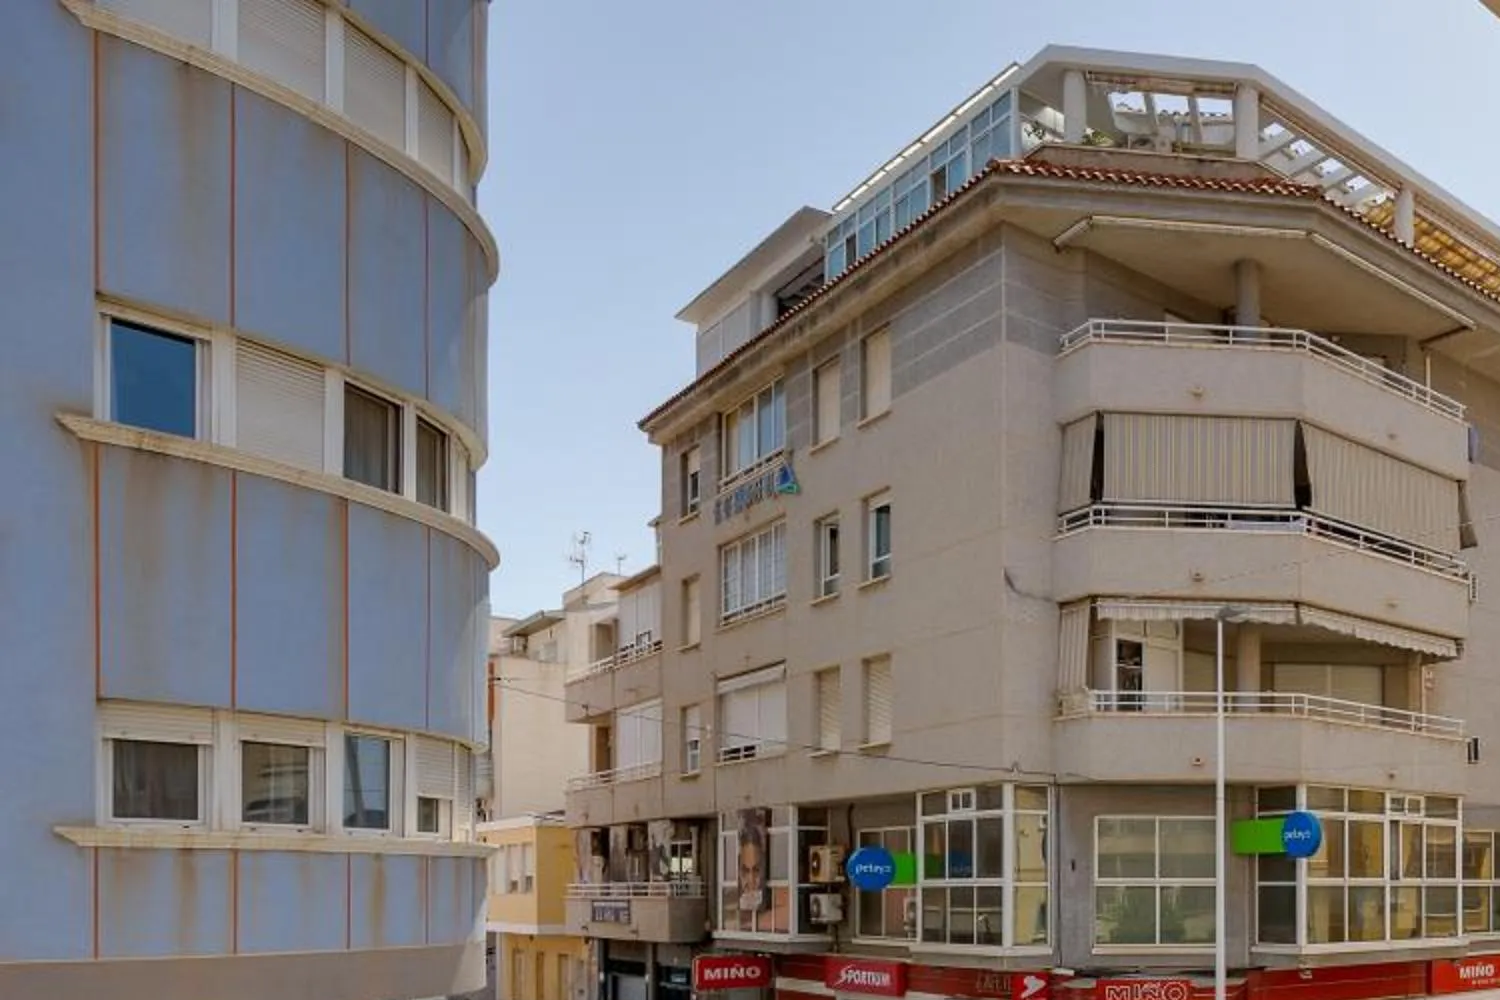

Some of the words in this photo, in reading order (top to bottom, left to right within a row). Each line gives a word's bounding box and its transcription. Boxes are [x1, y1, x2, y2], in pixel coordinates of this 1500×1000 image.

[703, 963, 761, 981] MIÑO
[837, 964, 891, 986] SPORTIUM
[1460, 961, 1495, 978] MIÑO
